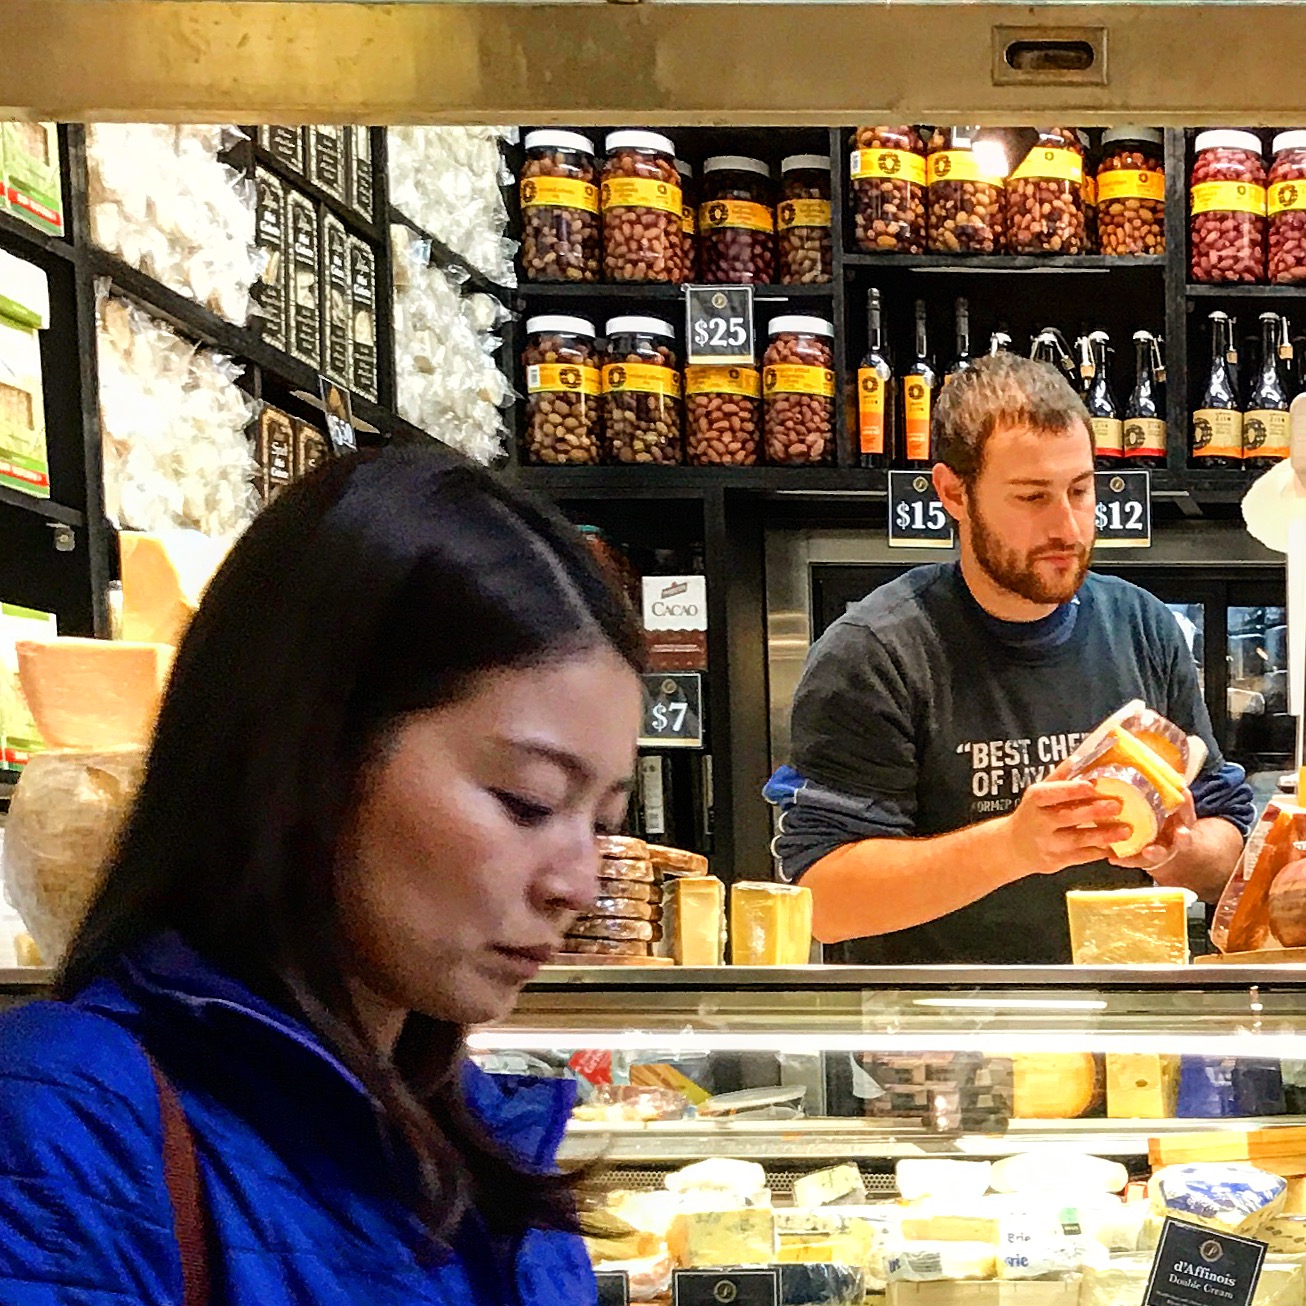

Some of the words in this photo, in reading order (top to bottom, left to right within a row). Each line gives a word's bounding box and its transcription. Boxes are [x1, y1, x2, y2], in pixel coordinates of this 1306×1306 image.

[694, 317, 748, 347] $25
[896, 500, 946, 530] $15
[1095, 501, 1143, 531] $12
[652, 602, 698, 617] CACAO
[652, 702, 688, 732] $7
[972, 770, 1005, 797] OF
[1011, 765, 1045, 793] MY
[1007, 1232, 1031, 1243] Brie
[1168, 1273, 1201, 1290] Double
[1203, 1283, 1234, 1300] Cream
[1173, 1260, 1236, 1287] d'Affinois
